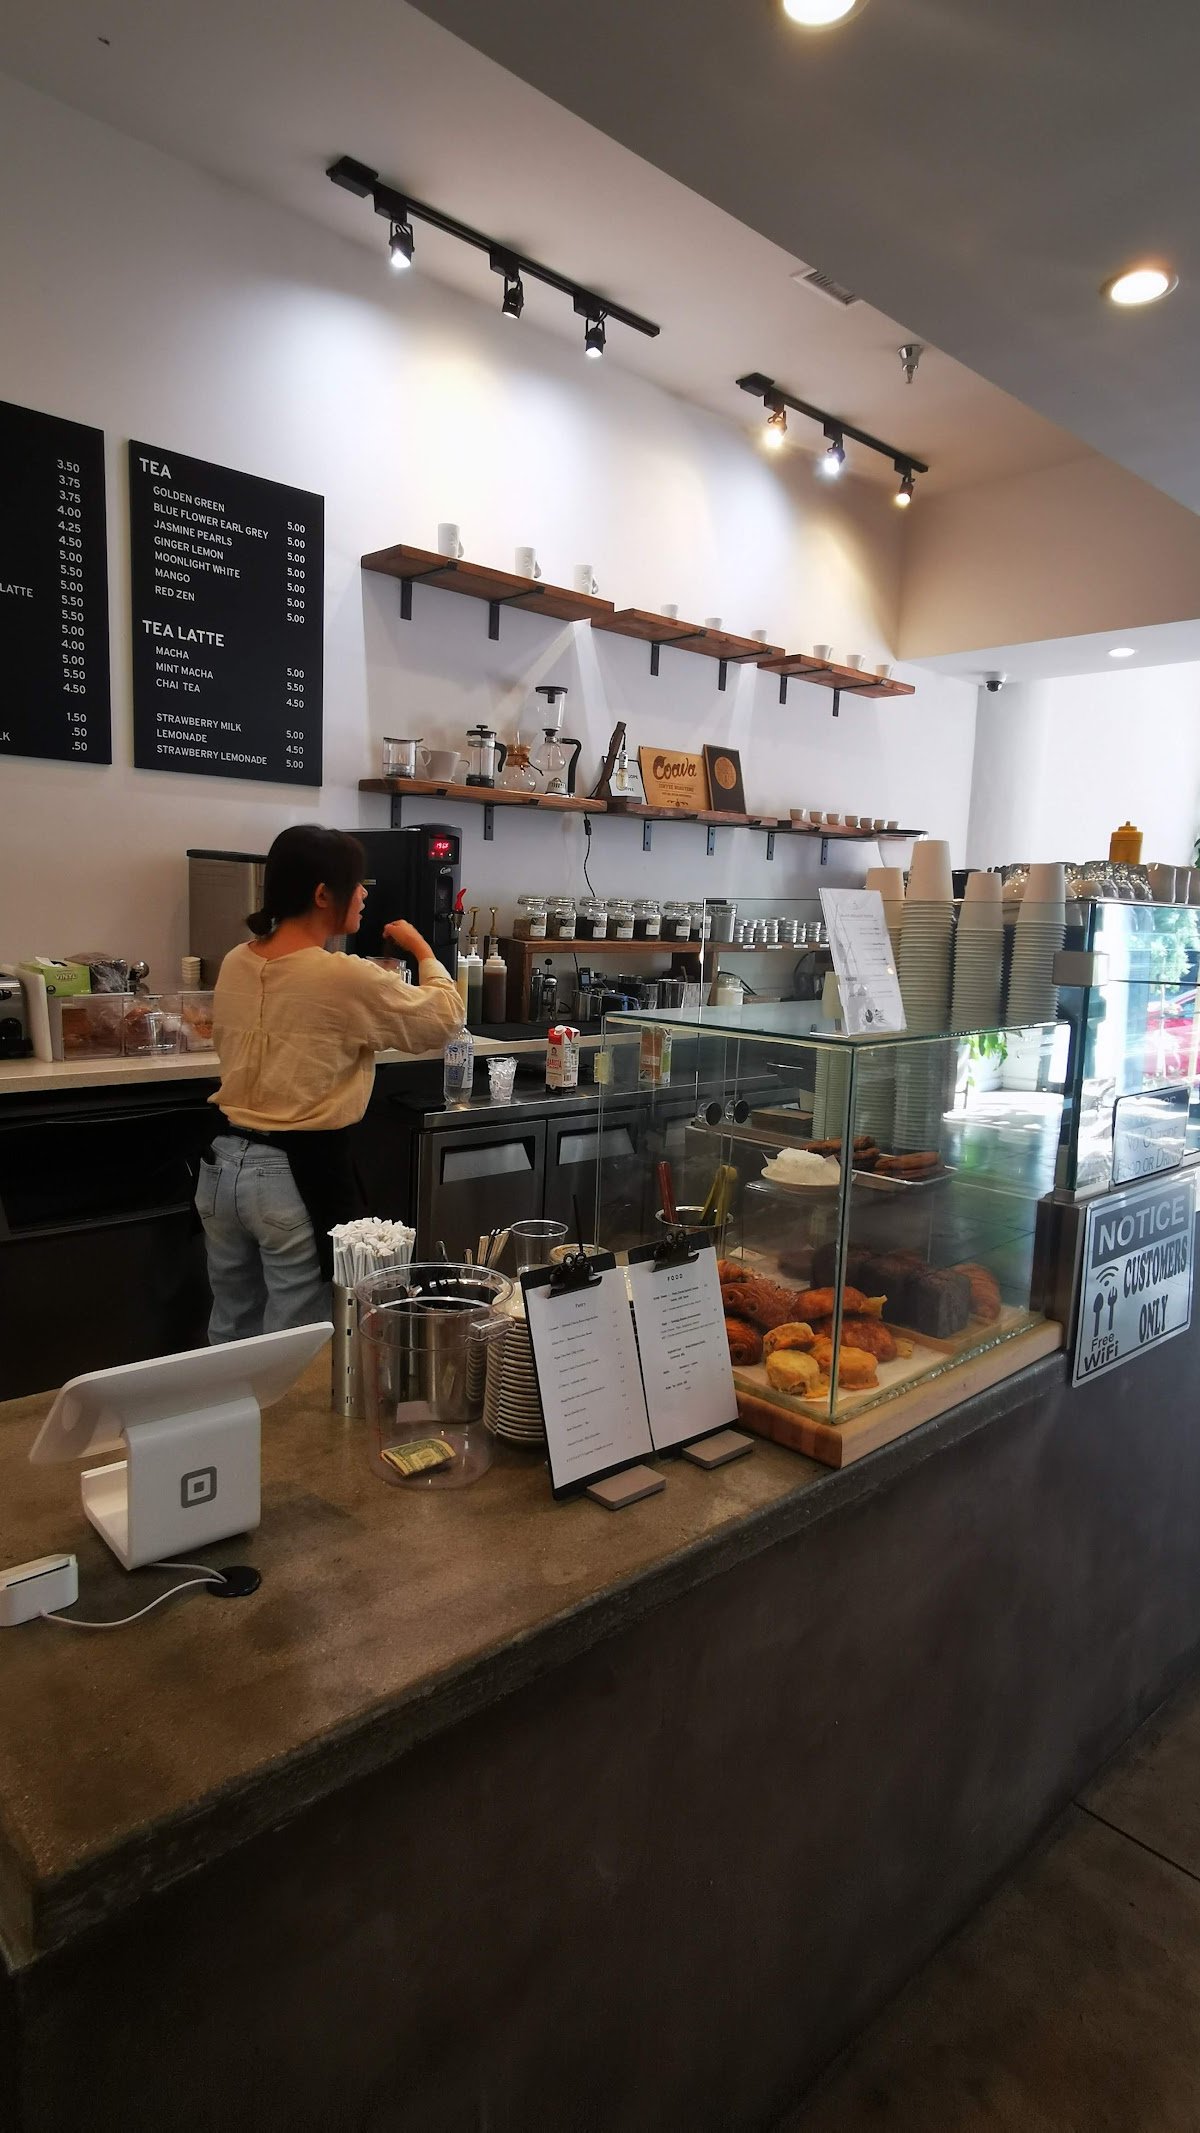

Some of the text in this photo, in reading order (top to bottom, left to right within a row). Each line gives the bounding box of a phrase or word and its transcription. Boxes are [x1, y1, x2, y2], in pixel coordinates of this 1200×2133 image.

[57, 460, 80, 473] 3.50
[139, 458, 172, 479] TEA
[59, 475, 80, 488] 3.75
[60, 490, 80, 503] 3.75
[57, 506, 81, 518] 4.00
[153, 486, 306, 533] GOLDEN GREEN 5.00
[58, 521, 81, 533] 4.25
[154, 503, 305, 549] BLUE FLOWER EARL GREY 5.00
[58, 536, 82, 548] 4.50
[154, 520, 305, 564] JASMINE PEARLS 5.00
[60, 550, 82, 563] 5.00
[154, 536, 305, 579] GINGER LEMON 5.00
[60, 565, 82, 578] 5.50
[155, 551, 305, 594] MOONLIGHT WHITE 5.00
[0, 583, 84, 608] LATTE 5.50
[60, 580, 83, 592] 5.00
[155, 568, 305, 609] MANGO 5.00
[155, 585, 305, 624] RED ZEN 5.00
[62, 610, 84, 622] 5.50
[62, 624, 84, 636] 5.00
[142, 620, 225, 647] TEA LATTE
[61, 640, 84, 651] 4.00
[62, 654, 84, 666] 5.00
[156, 646, 304, 678] MACHA 5.00
[63, 668, 86, 680] 5.50
[156, 662, 304, 692] MINT MACHA 5.50
[63, 684, 86, 694] 4.50
[156, 679, 304, 708] CHAI TEA 4.50
[66, 712, 86, 722] 1.50
[156, 713, 304, 740] STRAWBERRY MILK 5.00
[72, 727, 87, 737] .50
[156, 729, 304, 754] LEMONADE 4.50
[72, 742, 88, 751] .50
[156, 745, 304, 769] STRAWBERRY LEMONADE 5.00
[652, 755, 698, 780] Coava
[1100, 1195, 1185, 1256] NOTICE
[1124, 1235, 1188, 1299] CUSTOMERS
[1138, 1294, 1169, 1344] ONLY
[1091, 1333, 1115, 1352] Free
[1084, 1340, 1119, 1372] WiFi
